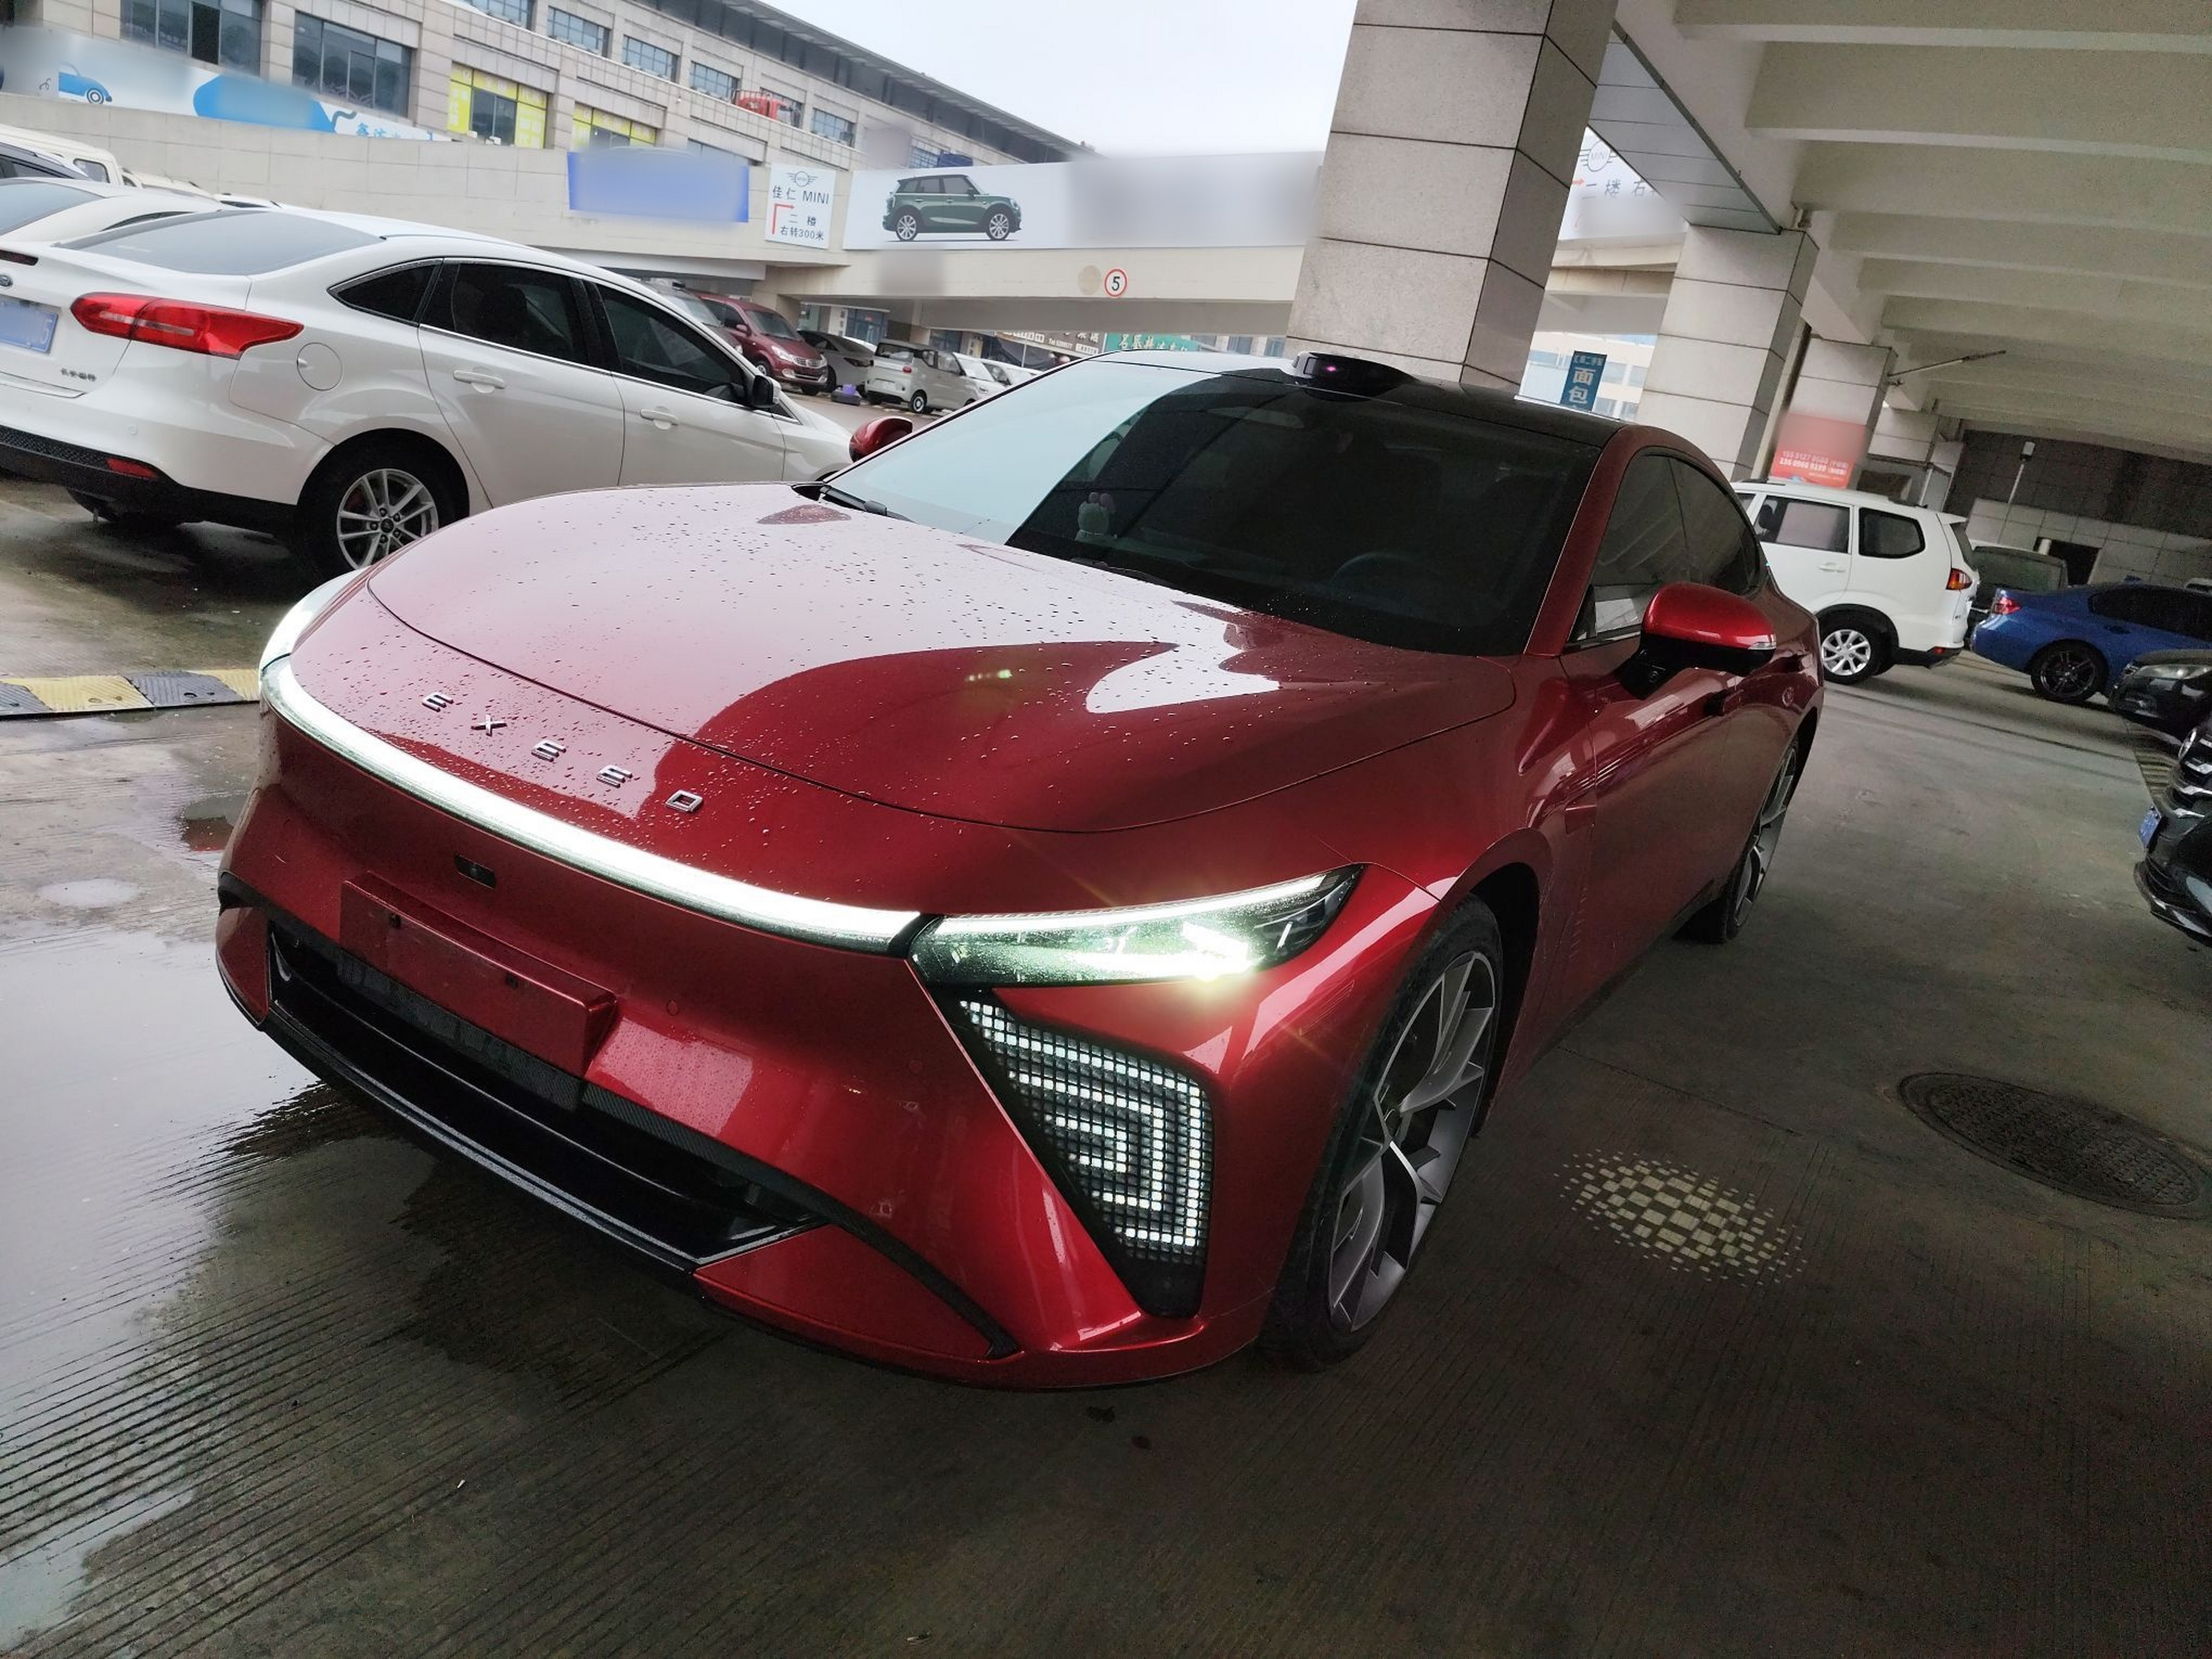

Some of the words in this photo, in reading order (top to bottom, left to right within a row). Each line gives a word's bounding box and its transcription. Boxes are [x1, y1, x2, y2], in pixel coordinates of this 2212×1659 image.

[772, 185, 797, 200] 佳仁
[802, 190, 829, 204] MINI
[781, 225, 824, 241] 右转300米
[1111, 276, 1120, 291] 5
[1568, 367, 1596, 410] 面包
